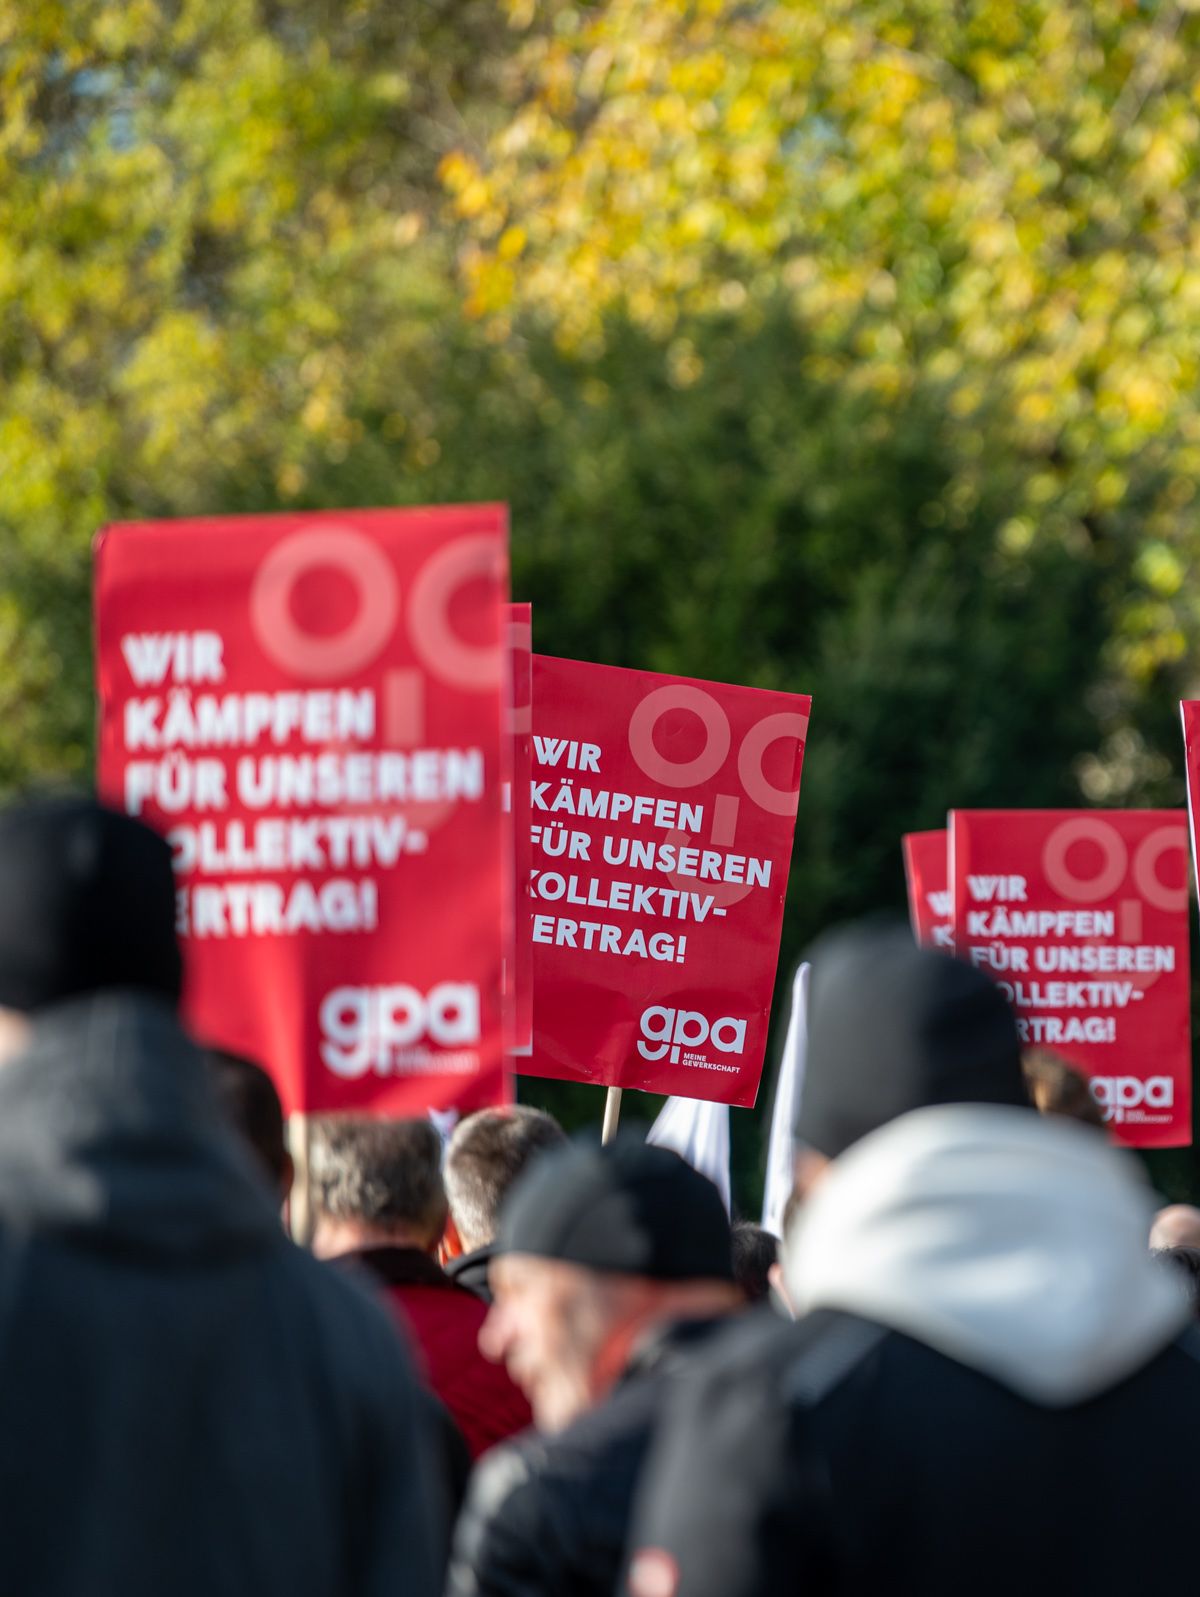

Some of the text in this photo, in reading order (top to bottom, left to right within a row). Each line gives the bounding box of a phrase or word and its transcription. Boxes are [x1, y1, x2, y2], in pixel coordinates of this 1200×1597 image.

[122, 631, 223, 683] WIR
[125, 690, 375, 750] KÄMPFEN
[532, 735, 602, 773] WIR
[125, 750, 227, 814] FÜR
[237, 750, 483, 808] UNSEREN
[530, 778, 704, 834] KÄMPFEN
[166, 814, 428, 872] OLLEKTIV-
[602, 835, 773, 889] UNSEREN
[175, 879, 379, 938] RTRAG!
[967, 875, 1028, 902] WIR
[531, 913, 688, 964] ERTRAG!
[967, 905, 1115, 937] KÄMPFEN
[969, 941, 1176, 974] FÜR UNSEREN
[996, 981, 1144, 1008] LLEKTIV-
[320, 982, 480, 1078] gpa
[637, 1005, 748, 1064] gpa
[1014, 1016, 1116, 1044] RTRAG!
[682, 1059, 741, 1074] GEWERKSCHAFT
[683, 1052, 707, 1062] MEINE
[1088, 1075, 1174, 1124] gpa
